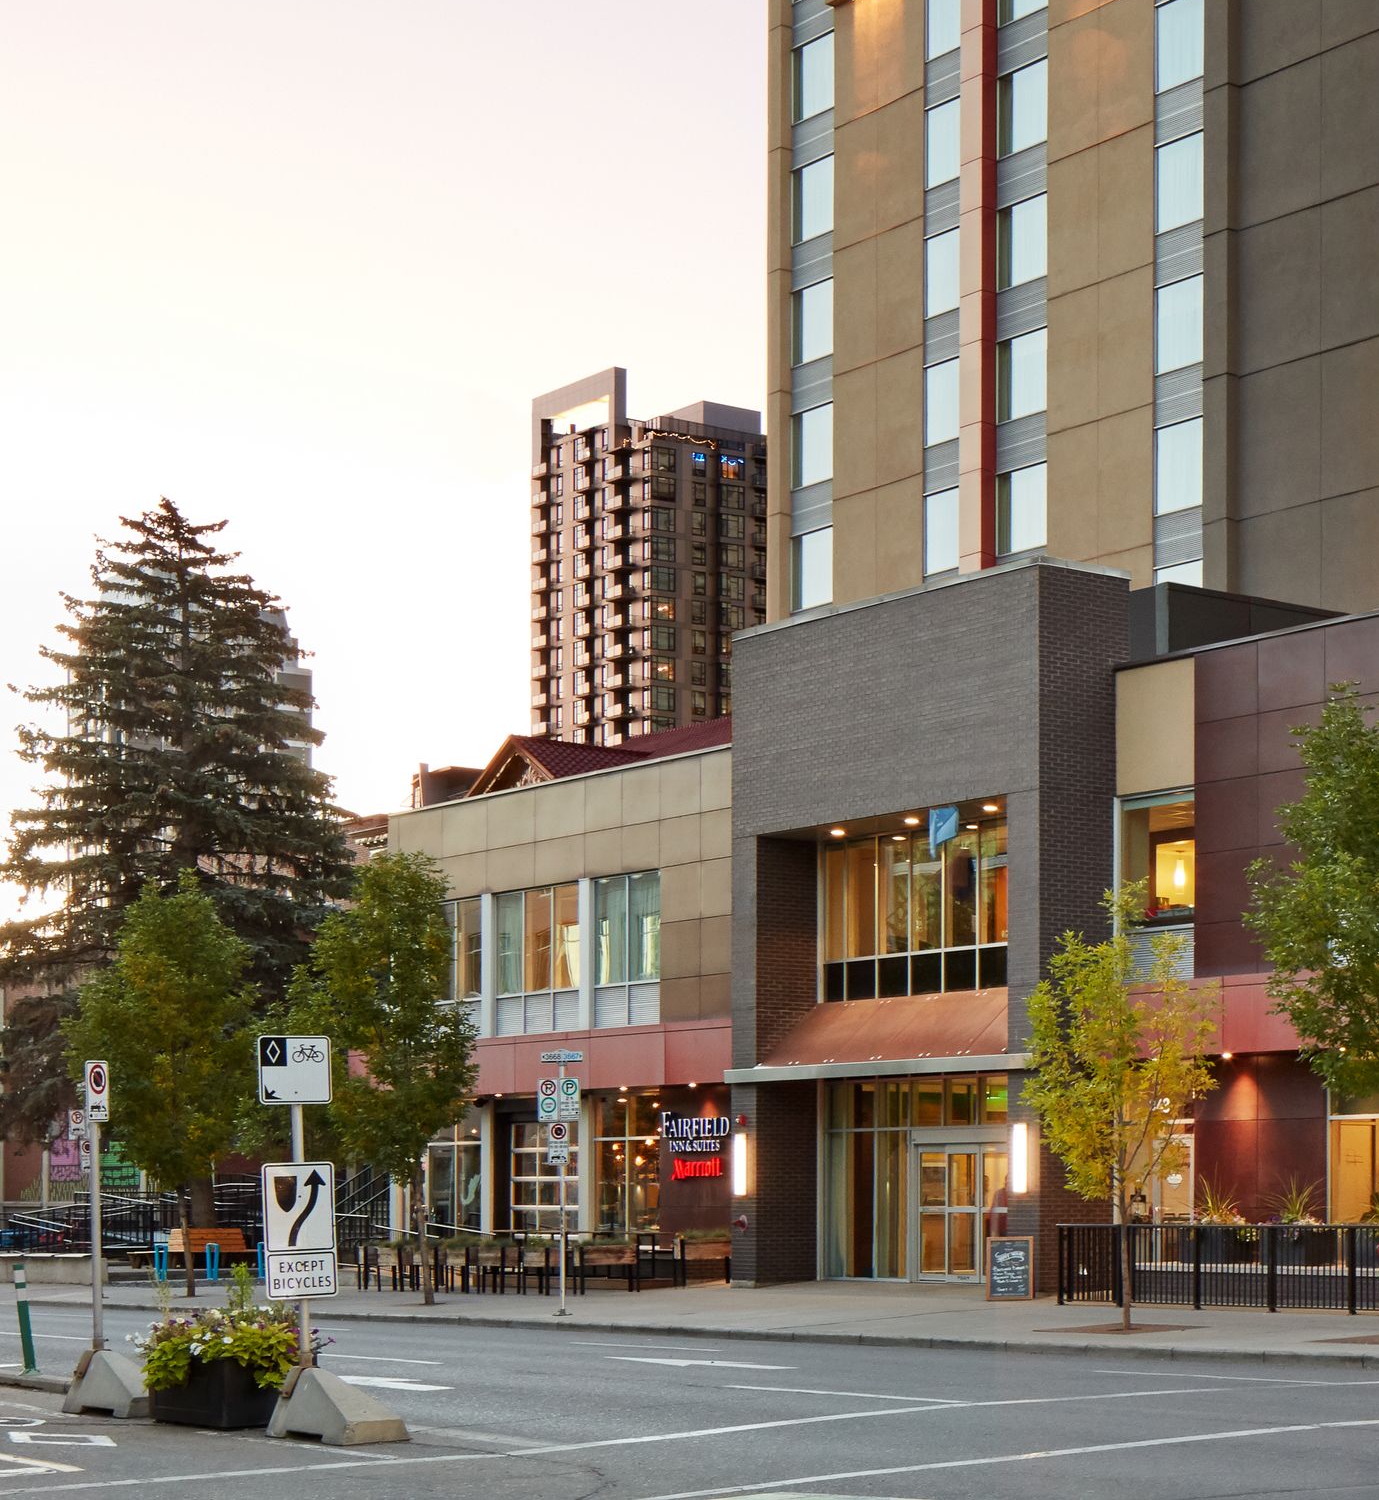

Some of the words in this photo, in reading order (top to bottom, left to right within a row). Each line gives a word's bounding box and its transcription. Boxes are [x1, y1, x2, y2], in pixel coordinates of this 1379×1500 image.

[671, 1157, 722, 1181] Marriott
[279, 1260, 325, 1274] EXCEPT
[273, 1275, 332, 1290] BICYCLES
